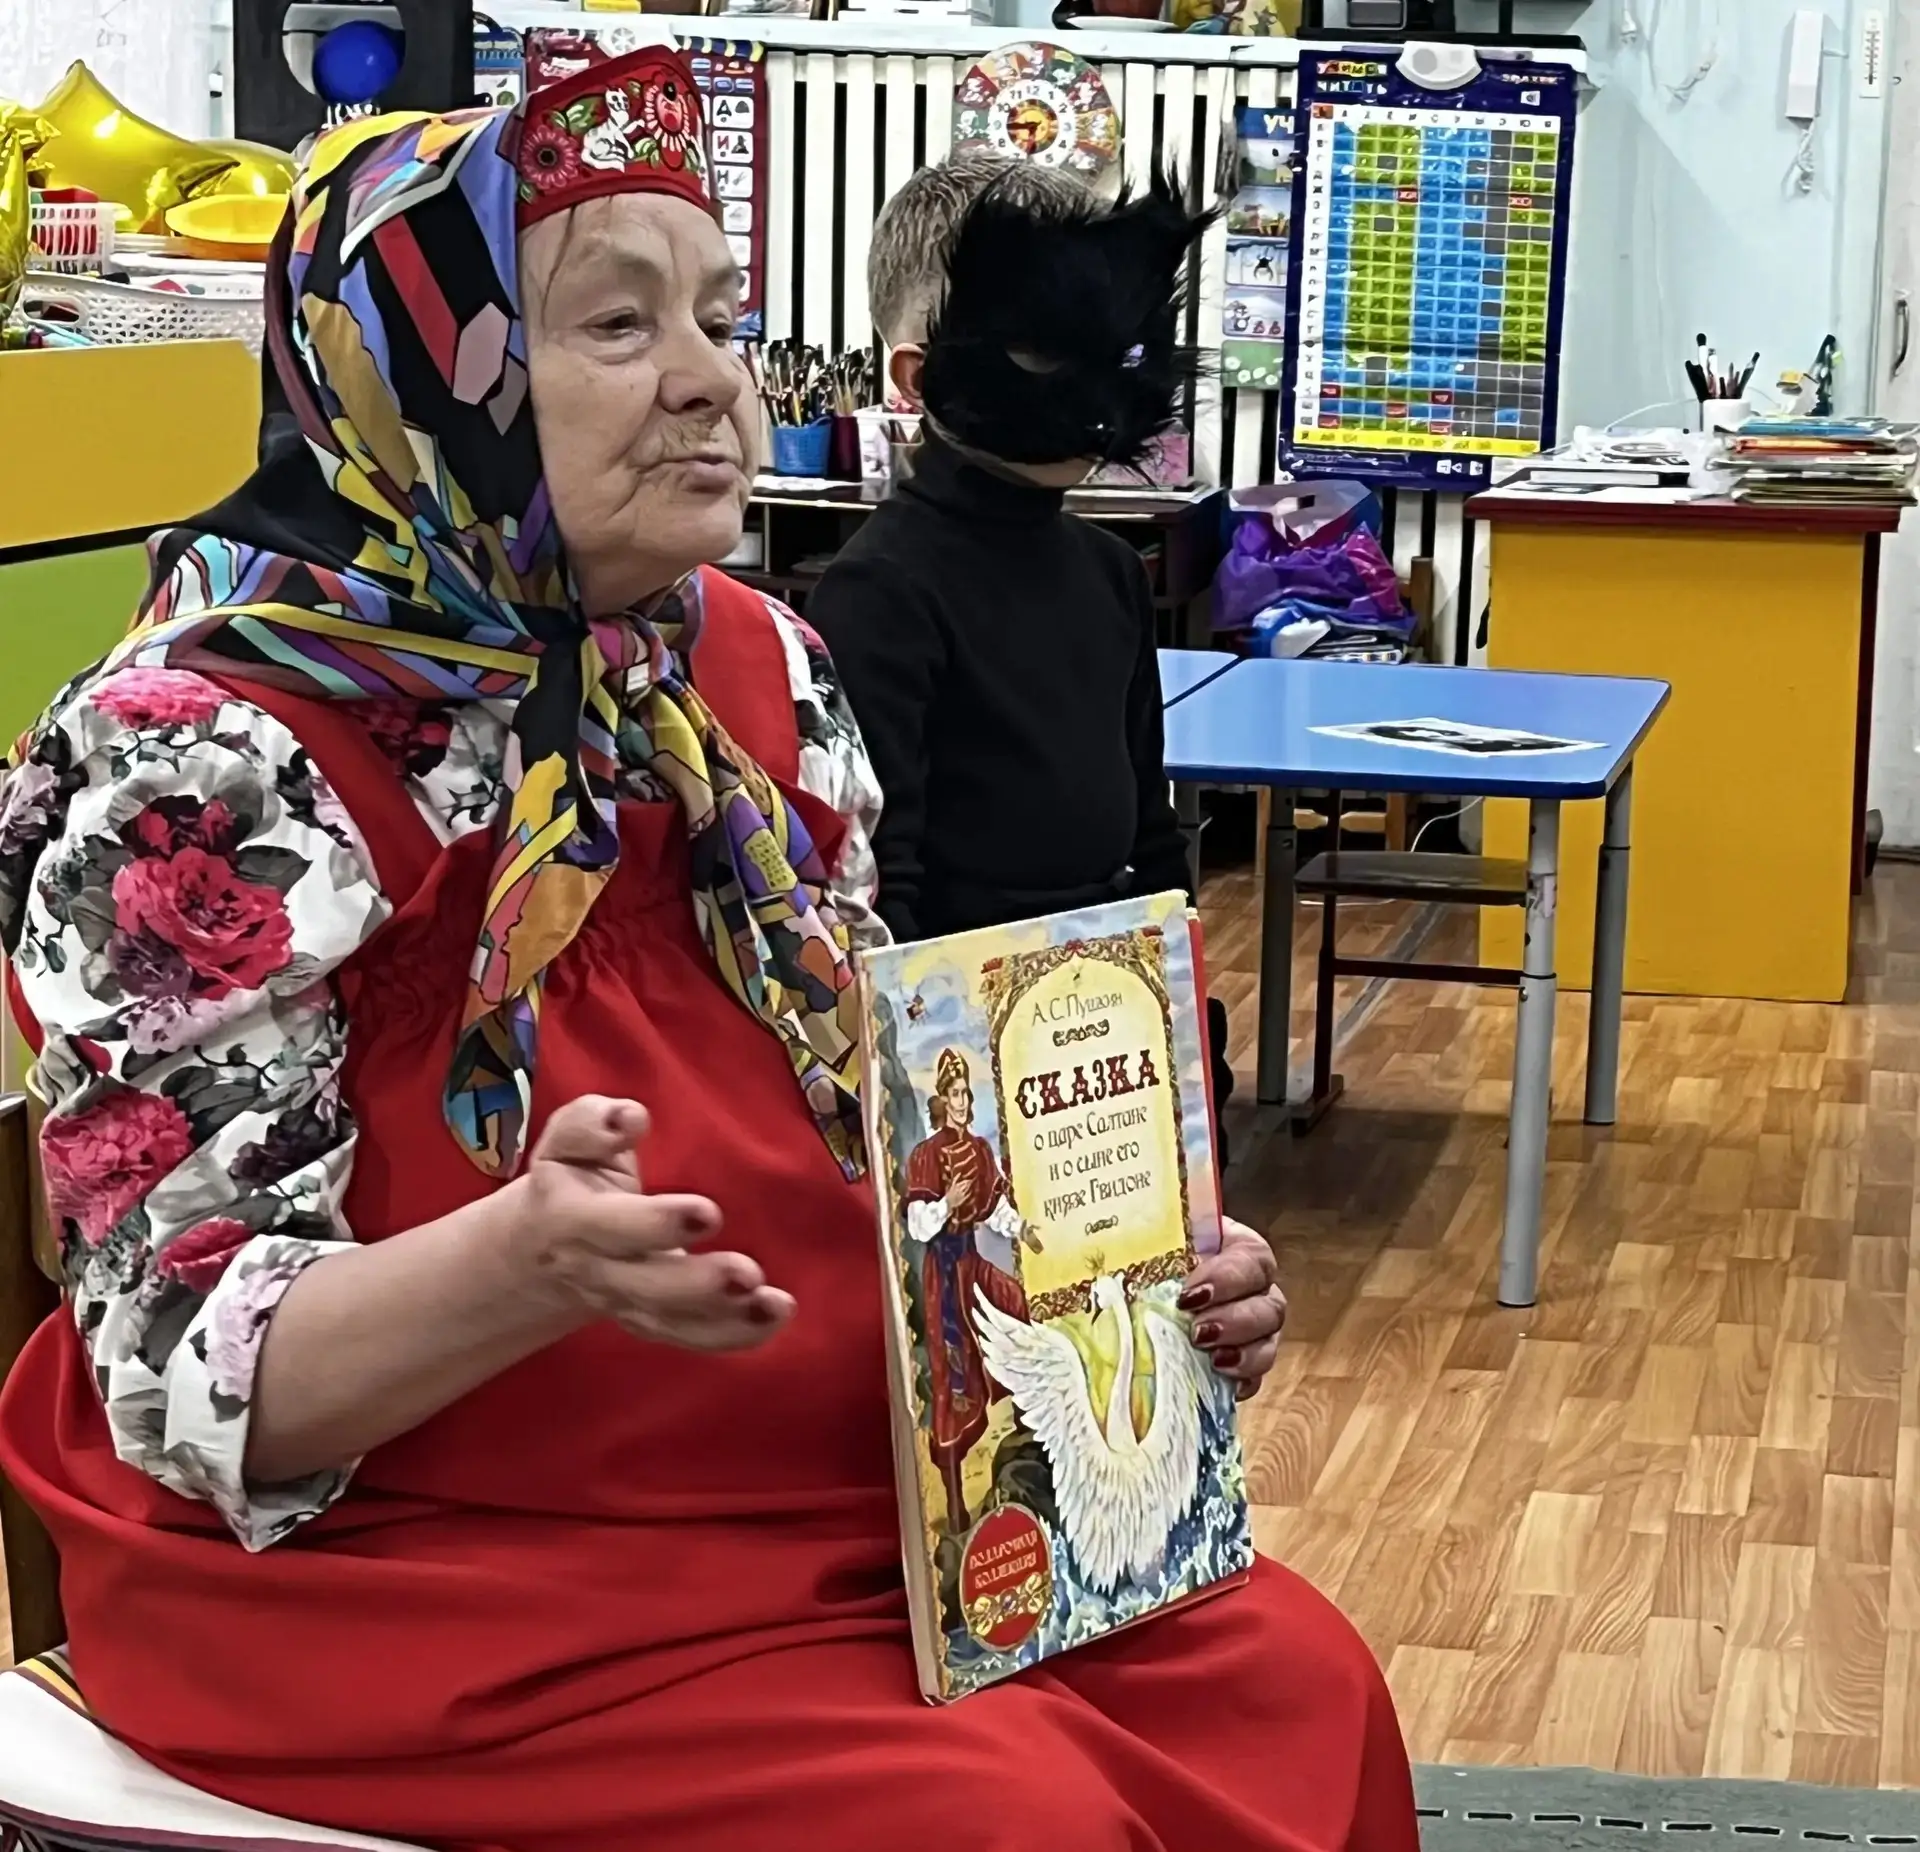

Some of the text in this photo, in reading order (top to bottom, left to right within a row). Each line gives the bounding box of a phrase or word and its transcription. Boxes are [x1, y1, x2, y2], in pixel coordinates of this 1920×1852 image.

[717, 135, 730, 151] И
[1014, 1048, 1160, 1119] СКАЗКА
[1034, 1133, 1044, 1151] о
[1063, 1160, 1074, 1177] о
[1116, 1140, 1140, 1162] его
